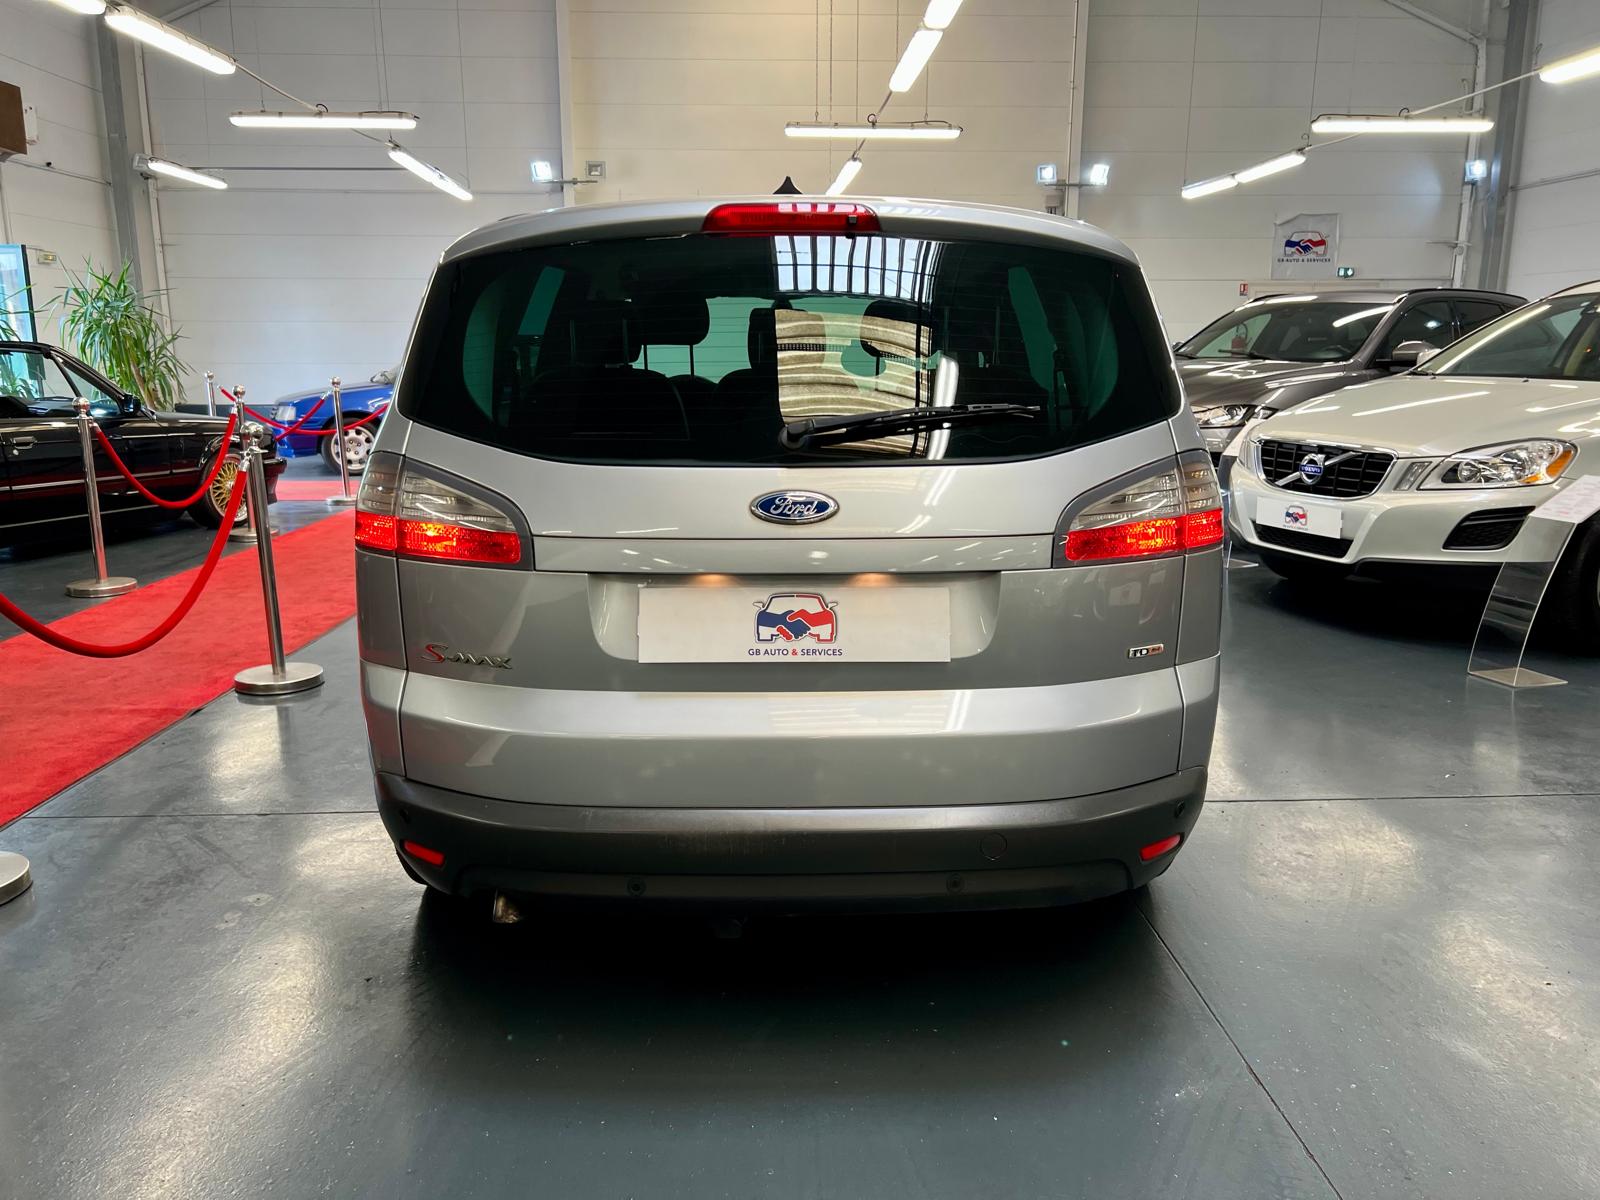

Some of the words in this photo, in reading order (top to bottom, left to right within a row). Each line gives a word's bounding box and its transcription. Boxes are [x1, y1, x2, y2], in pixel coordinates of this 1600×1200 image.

[770, 496, 817, 514] Ford
[748, 648, 761, 656] GB
[763, 648, 789, 656] AUTO
[791, 648, 798, 656] &
[800, 648, 843, 656] SERVICES
